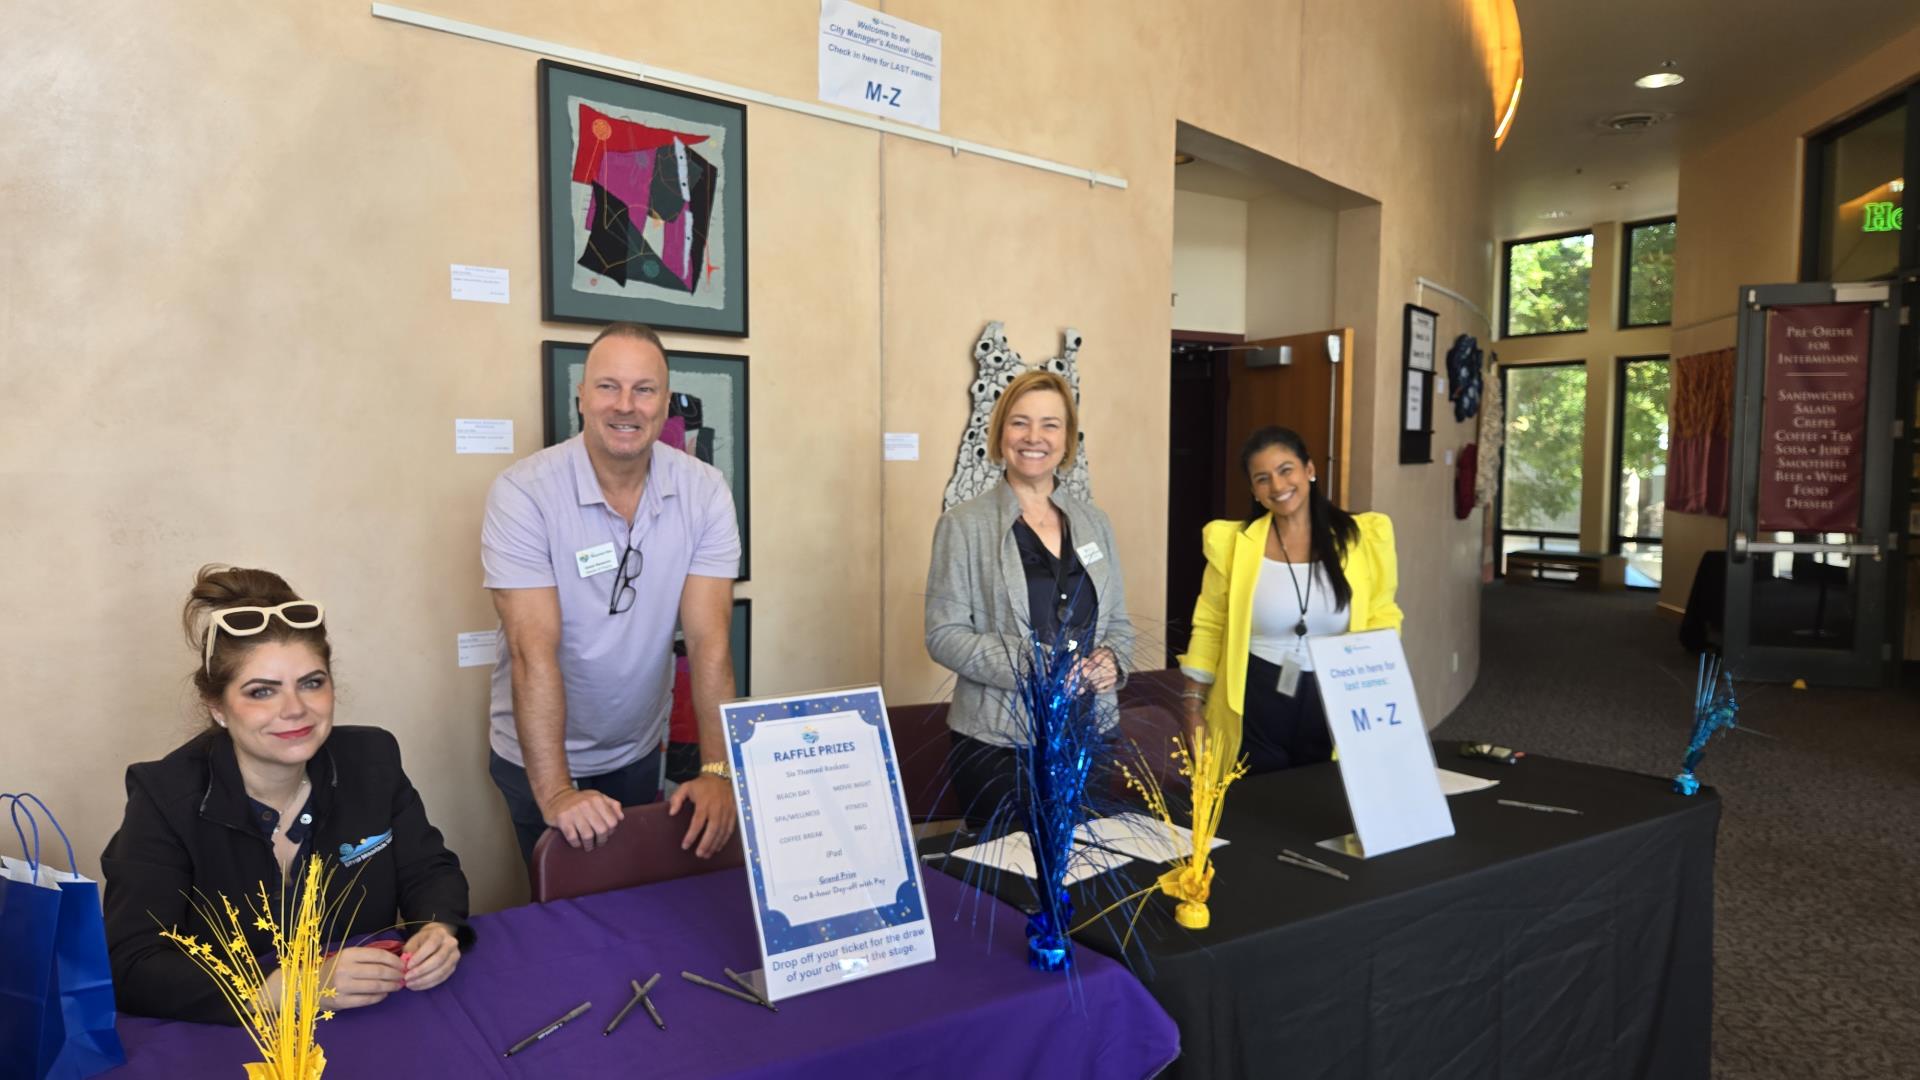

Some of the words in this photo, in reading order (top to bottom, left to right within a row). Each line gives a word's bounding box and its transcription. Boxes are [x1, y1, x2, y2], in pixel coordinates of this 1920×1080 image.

[829, 23, 846, 35] City
[886, 41, 909, 54] Annual
[911, 49, 933, 61] Update
[857, 20, 889, 37] Welcome
[891, 31, 899, 39] to
[900, 35, 911, 43] the
[828, 43, 851, 57] Check
[853, 51, 861, 59] in
[862, 54, 877, 64] here
[879, 58, 889, 67] for
[890, 62, 909, 74] LAST
[865, 80, 902, 107] M-Z
[1330, 666, 1356, 678] Check
[1385, 661, 1395, 670] for
[774, 747, 816, 762] RAFFLE
[819, 742, 855, 757] PRIZES
[797, 766, 824, 775] Themed
[798, 789, 811, 797] DAY
[779, 834, 802, 844] COFFEE
[803, 831, 823, 840] BREAK
[793, 894, 808, 902] One
[859, 879, 873, 888] with
[874, 877, 886, 886] Pay
[819, 874, 840, 885] Grand
[772, 957, 798, 972] Drop
[800, 952, 815, 965] off
[816, 948, 839, 961] your
[841, 940, 869, 954] ticket
[870, 937, 884, 948] for
[886, 932, 901, 944] the
[903, 927, 926, 940] draw
[786, 971, 797, 983] of
[799, 966, 822, 981] your
[871, 950, 887, 961] the
